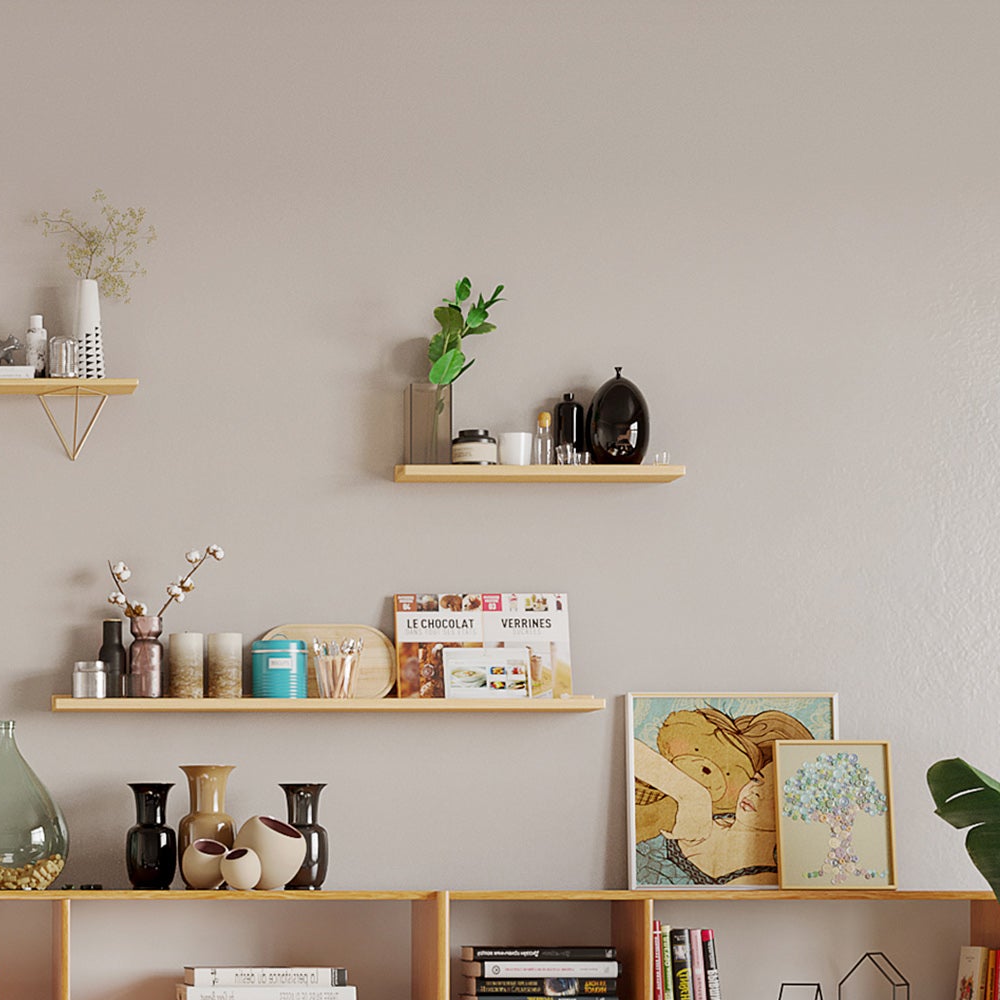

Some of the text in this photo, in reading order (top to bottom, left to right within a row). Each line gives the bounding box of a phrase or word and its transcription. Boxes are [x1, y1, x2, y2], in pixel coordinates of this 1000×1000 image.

[407, 619, 474, 628] LE CHOCOLAT
[501, 618, 552, 628] VERRINES
